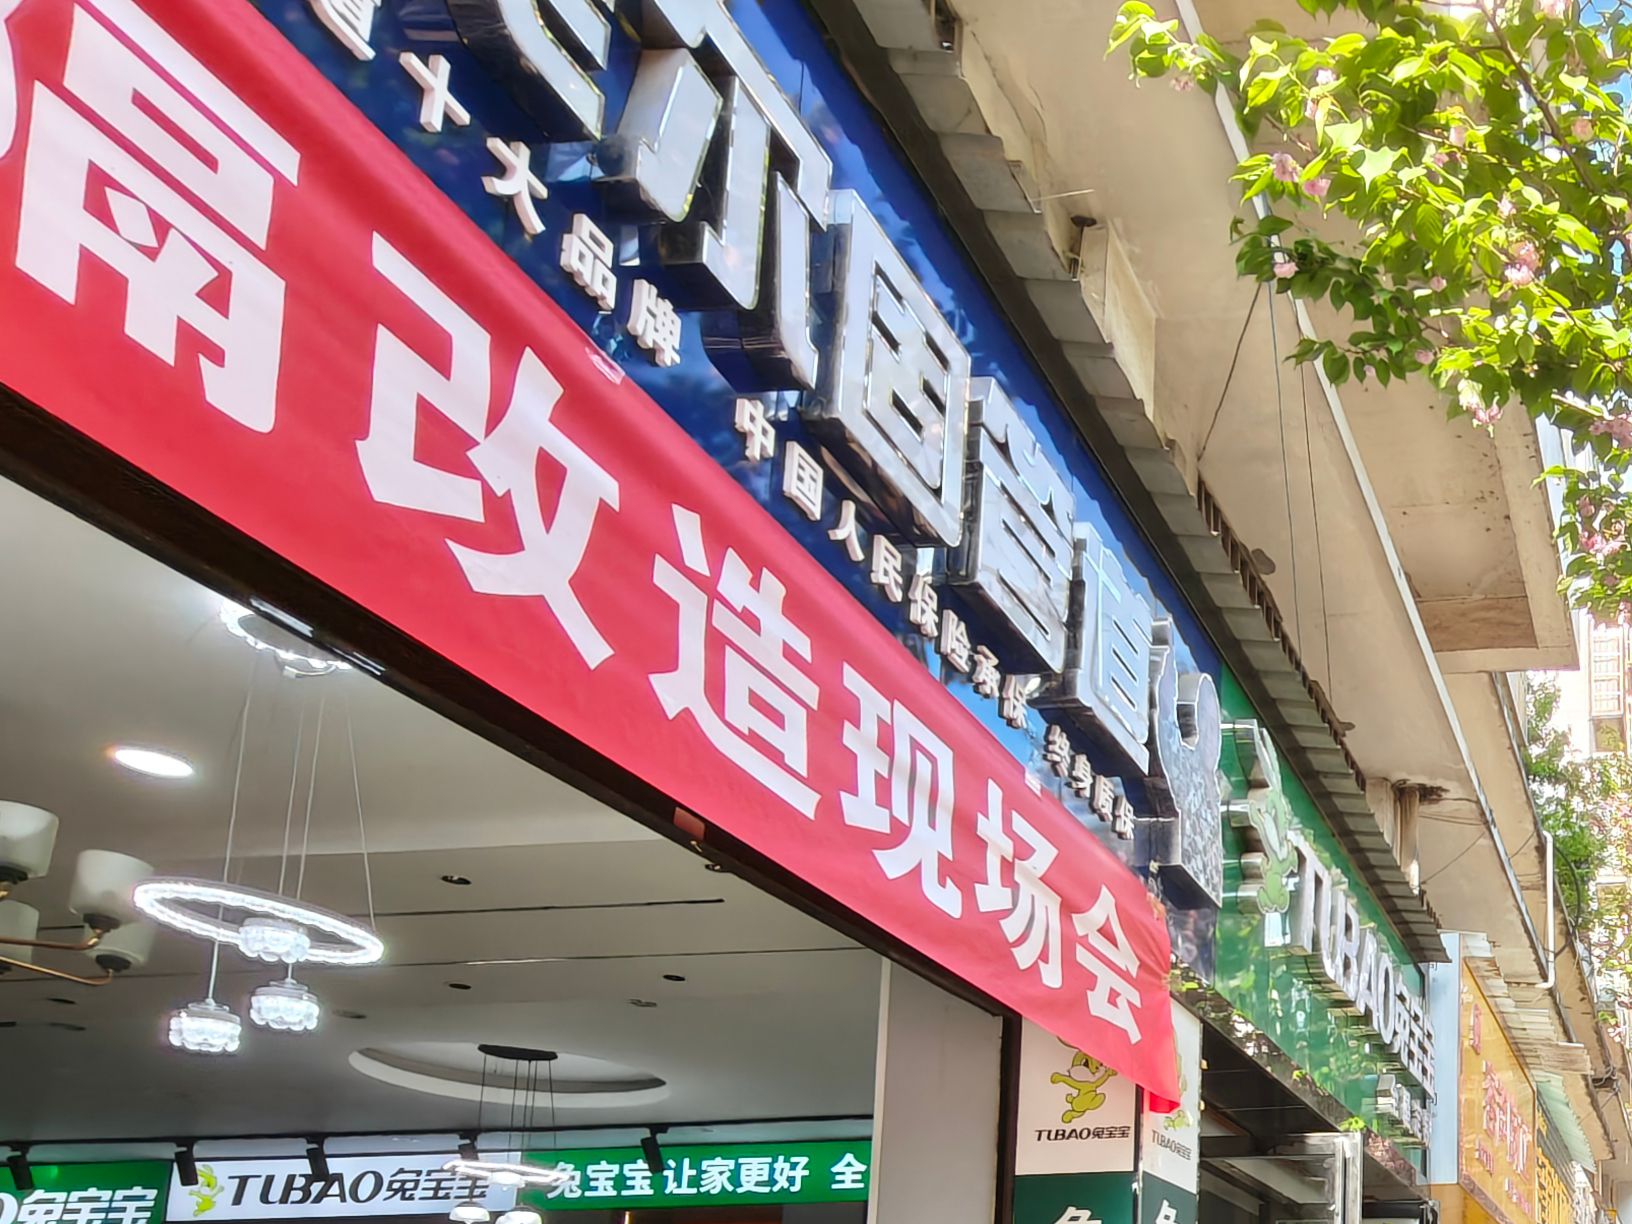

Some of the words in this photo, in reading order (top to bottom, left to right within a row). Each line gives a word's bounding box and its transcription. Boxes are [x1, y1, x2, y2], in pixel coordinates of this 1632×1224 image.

[1034, 1125, 1131, 1142] TUBAO兔宝宝
[227, 1167, 491, 1206] TUBAO兔宝宝
[546, 1155, 810, 1200] 兔宝宝让家更好
[830, 1153, 868, 1190] 全
